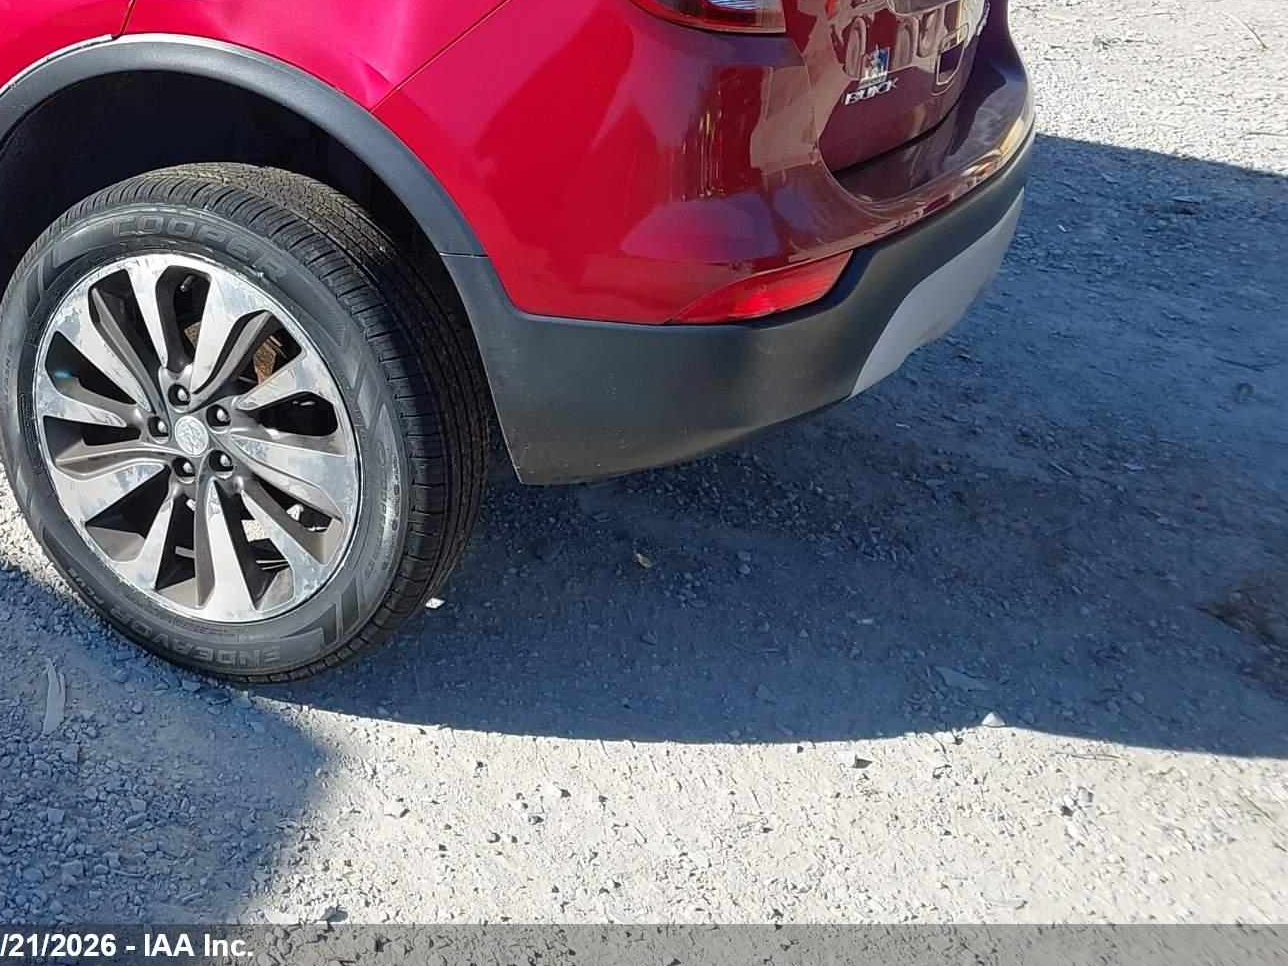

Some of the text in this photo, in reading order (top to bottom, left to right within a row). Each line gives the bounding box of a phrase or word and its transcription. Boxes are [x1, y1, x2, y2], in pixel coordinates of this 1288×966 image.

[843, 77, 899, 106] BUICK
[113, 214, 288, 283] COOPER
[112, 606, 281, 666] ENDEAVOR
